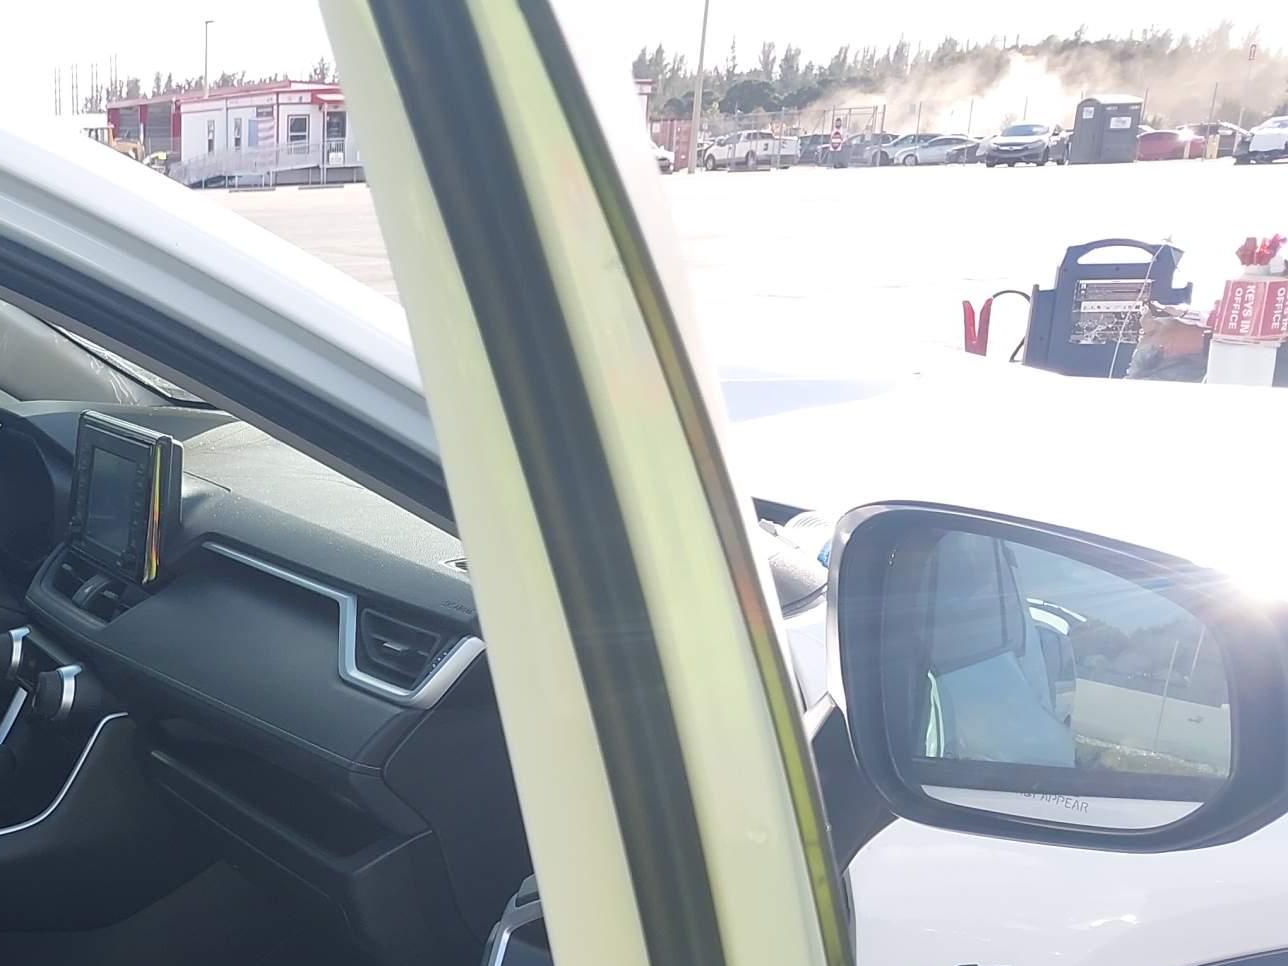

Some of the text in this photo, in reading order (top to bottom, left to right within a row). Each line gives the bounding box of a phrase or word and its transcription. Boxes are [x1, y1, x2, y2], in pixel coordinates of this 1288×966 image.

[1228, 287, 1243, 329] OFFICE
[1239, 285, 1256, 333] KEYS IN
[1271, 287, 1286, 329] OFFICE
